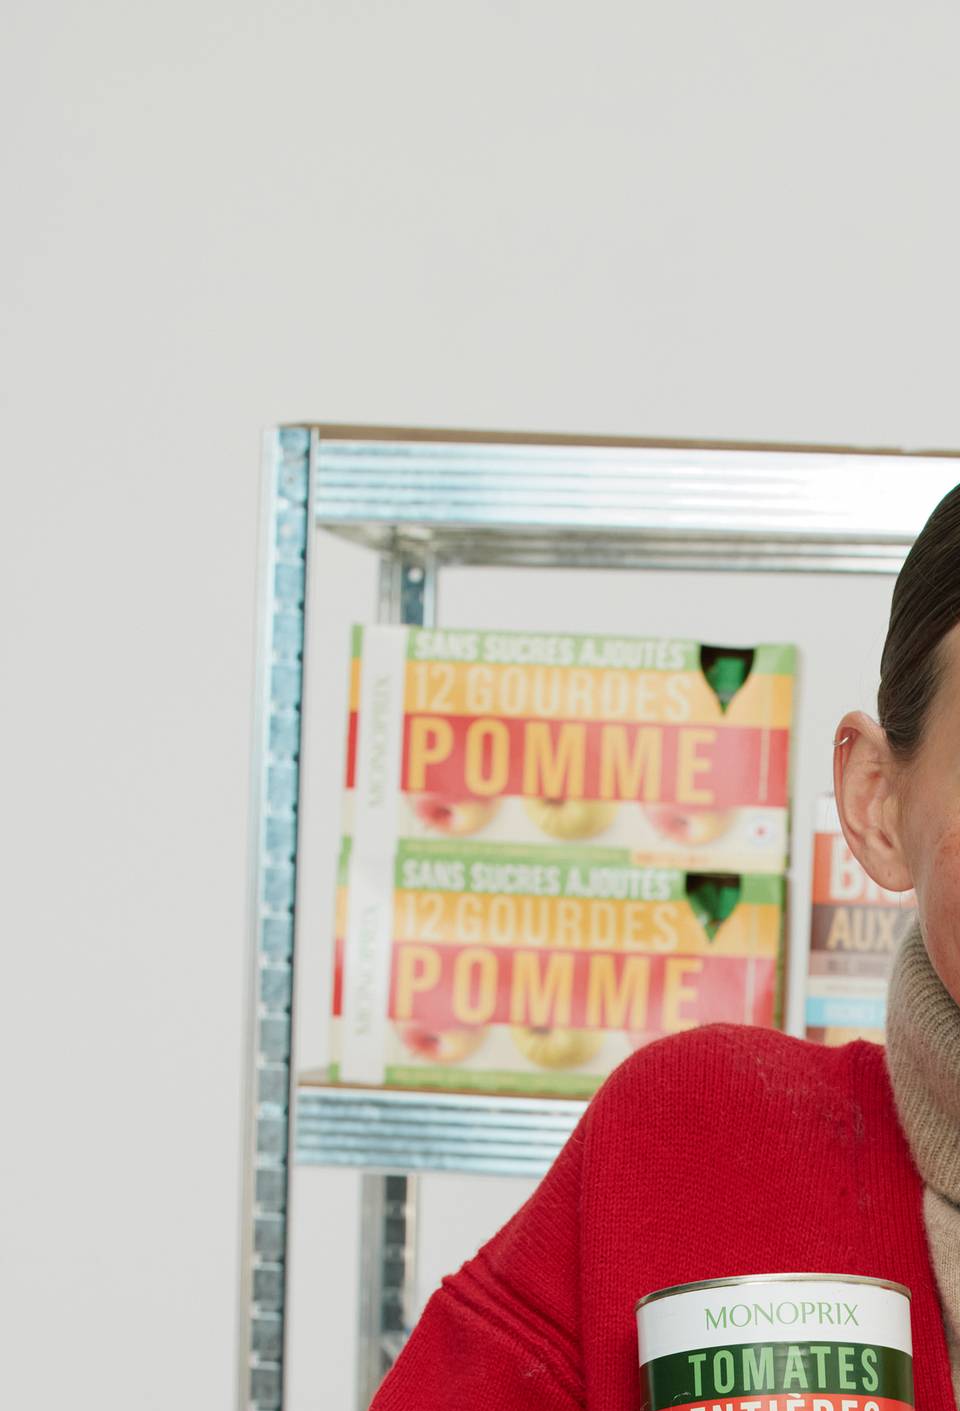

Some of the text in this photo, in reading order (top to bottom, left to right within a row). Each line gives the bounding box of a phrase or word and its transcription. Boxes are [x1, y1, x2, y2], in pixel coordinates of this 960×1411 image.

[415, 633, 477, 661] SANS
[488, 636, 575, 664] SUCRES
[415, 667, 691, 719] 12 GOURDES
[408, 717, 717, 802] POMME
[402, 860, 466, 889] SANS
[472, 863, 561, 896] SUCRES
[402, 895, 678, 946] 12 GOURDES
[826, 907, 896, 950] AUX
[396, 947, 704, 1032] POMME
[705, 1302, 859, 1330] MONOPRIX
[688, 1346, 879, 1397] TOMATES
